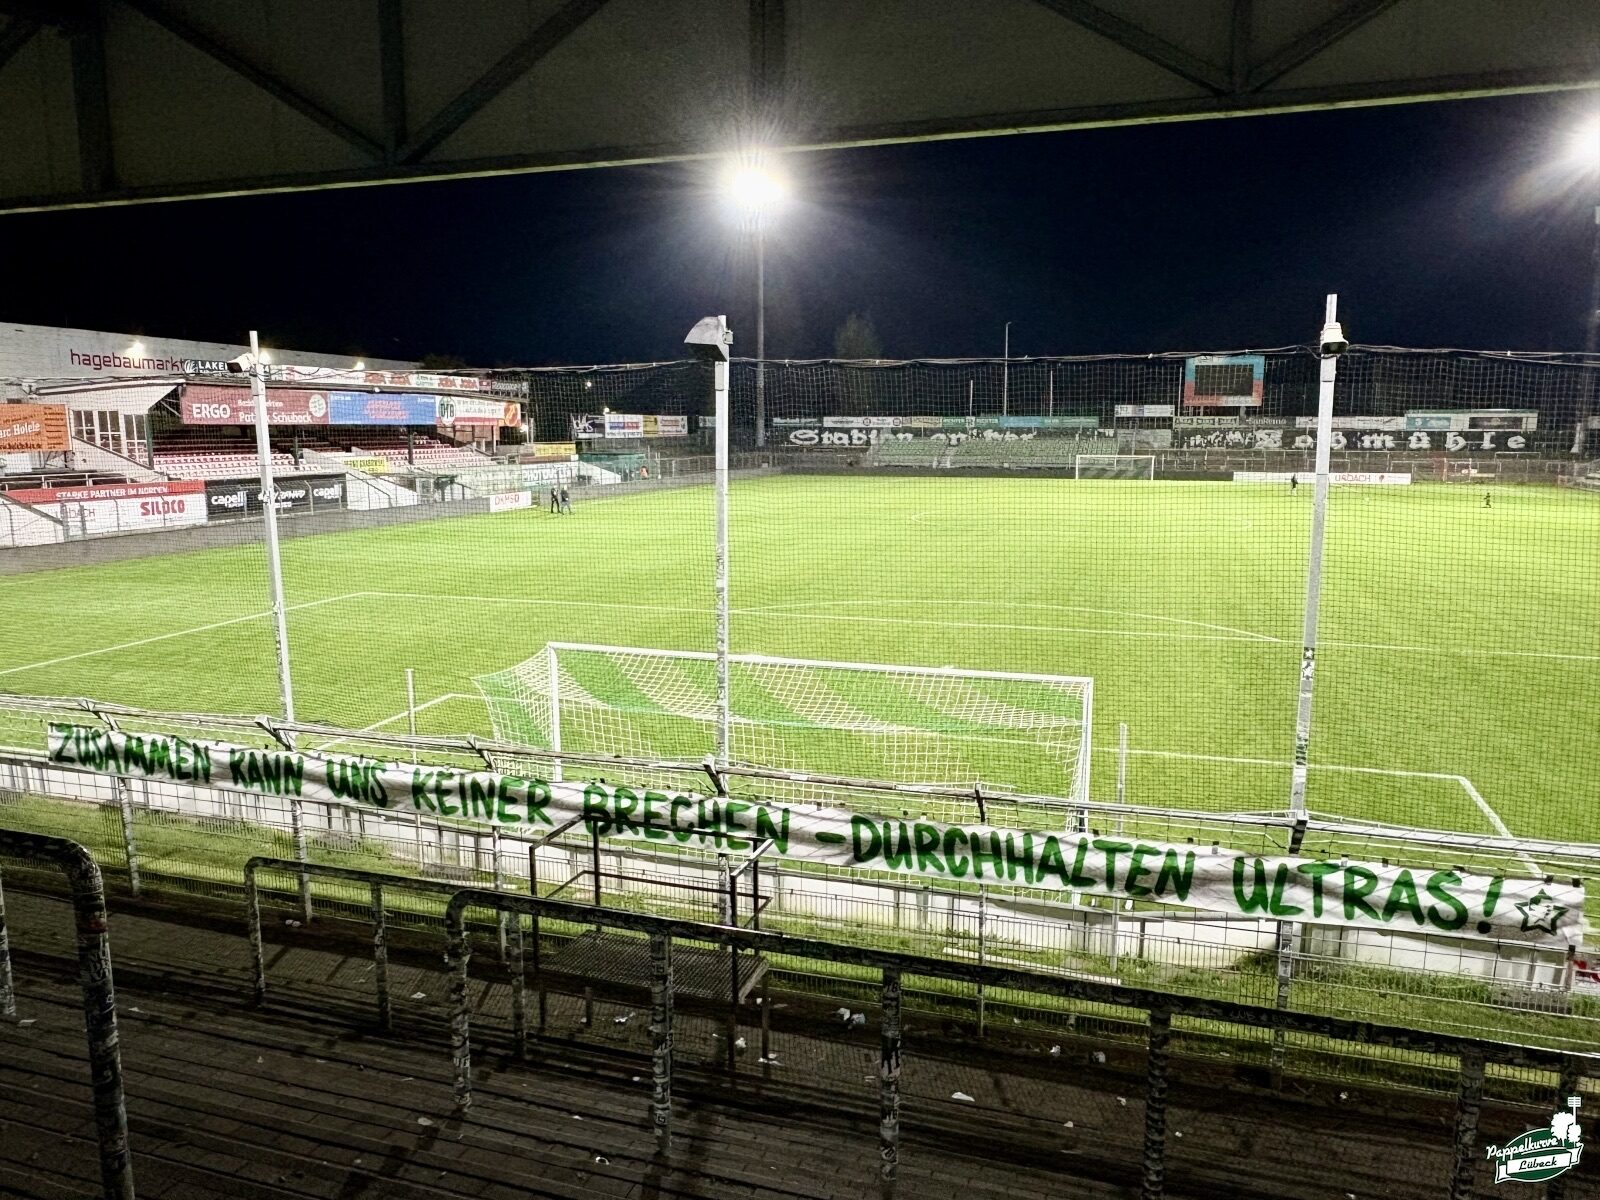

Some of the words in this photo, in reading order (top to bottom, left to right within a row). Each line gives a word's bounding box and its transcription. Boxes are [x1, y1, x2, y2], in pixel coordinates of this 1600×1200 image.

[70, 349, 184, 371] hagebaumarkt
[192, 404, 230, 418] ERGO
[239, 411, 270, 422] Patk
[90, 488, 126, 498] PARTNER
[128, 487, 137, 495] IM
[52, 722, 212, 783] ZUSAMMEN
[229, 747, 304, 797] KANN
[326, 758, 388, 808] UNS
[411, 767, 554, 826] KEINER
[583, 783, 790, 854] BRECHEN
